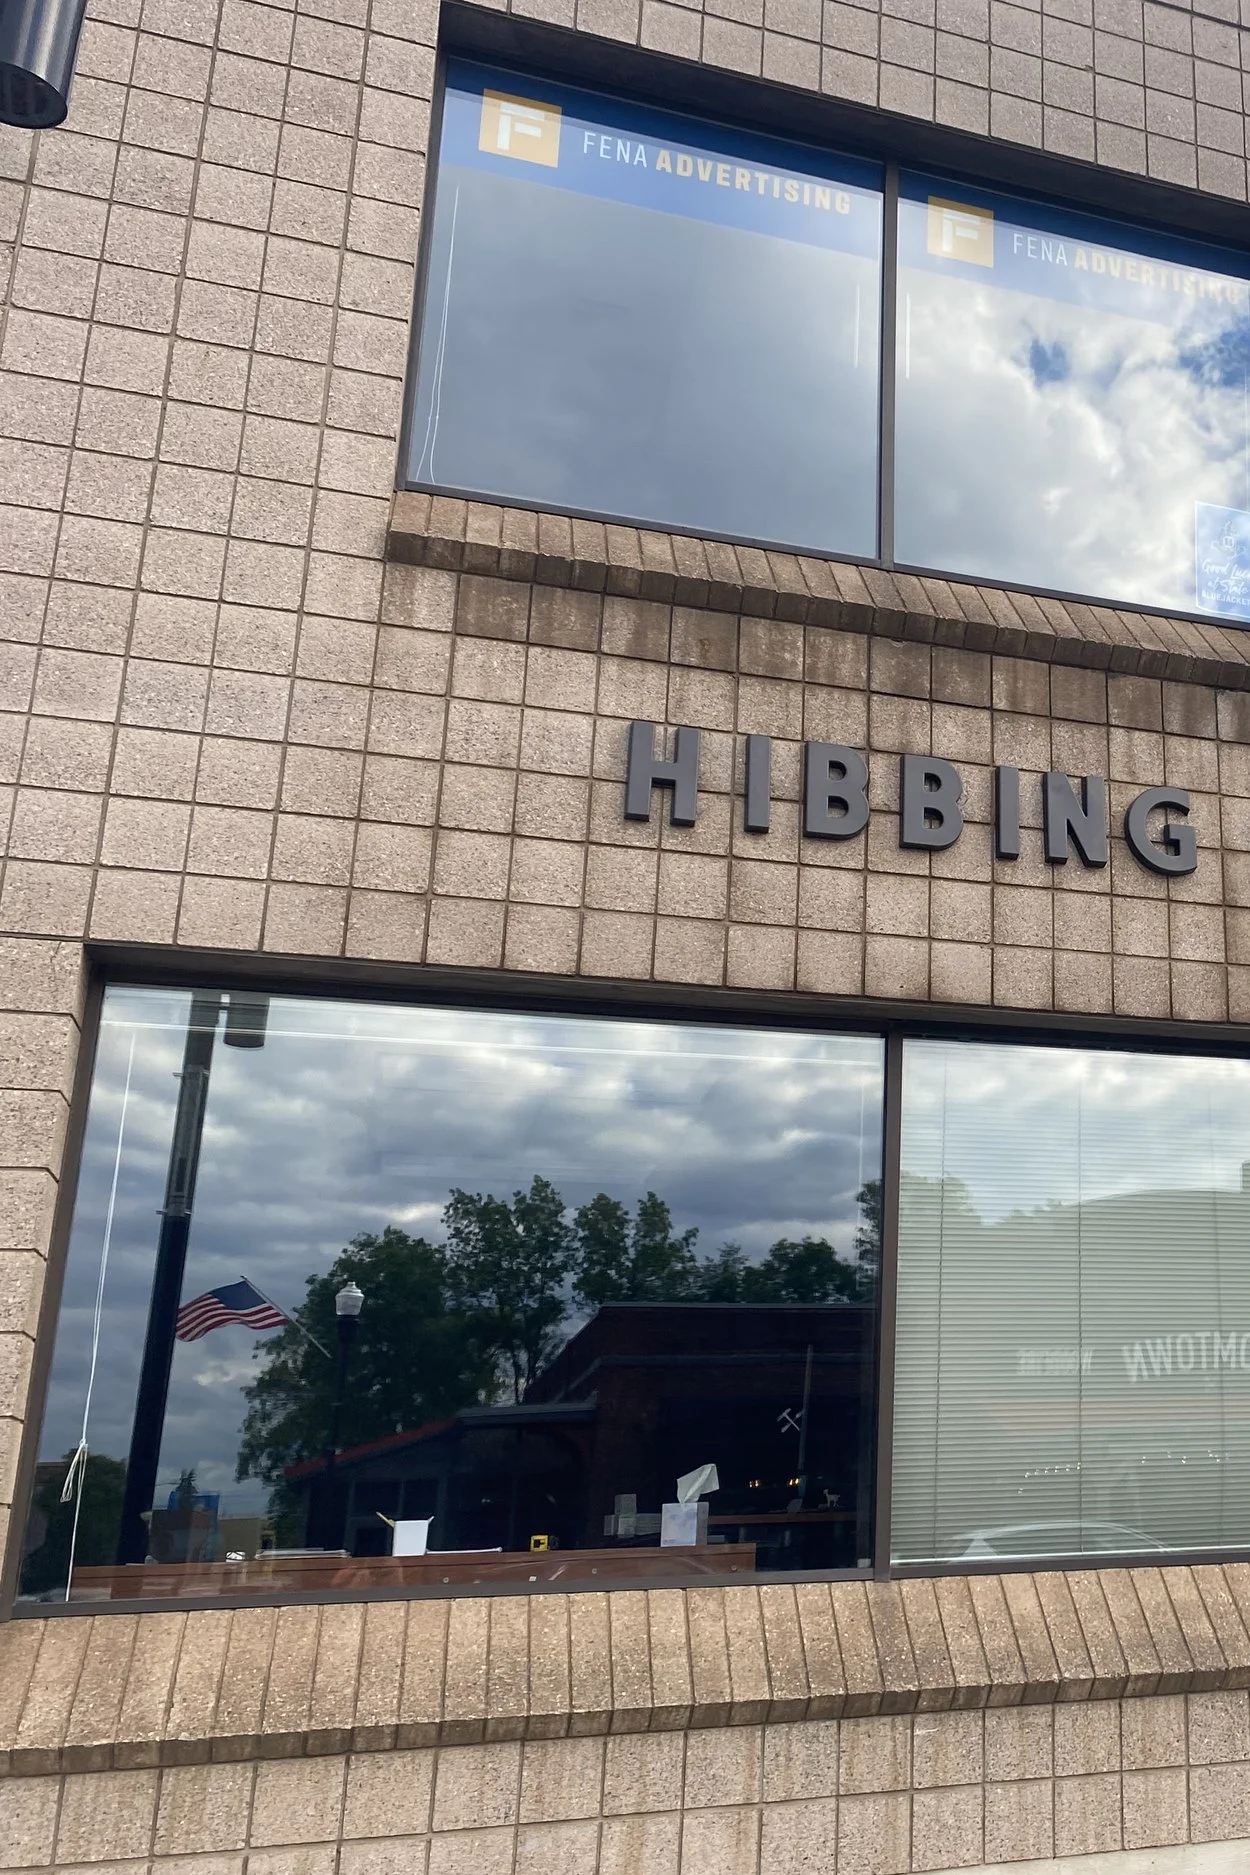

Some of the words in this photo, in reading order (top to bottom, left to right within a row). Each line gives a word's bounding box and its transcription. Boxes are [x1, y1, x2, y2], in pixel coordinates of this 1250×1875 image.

[583, 132, 648, 168] FENA
[655, 151, 851, 215] ADVERTISING
[1013, 232, 1068, 267] FENA
[1074, 247, 1240, 305] ADVERTISING
[624, 721, 1198, 876] HIBBING
